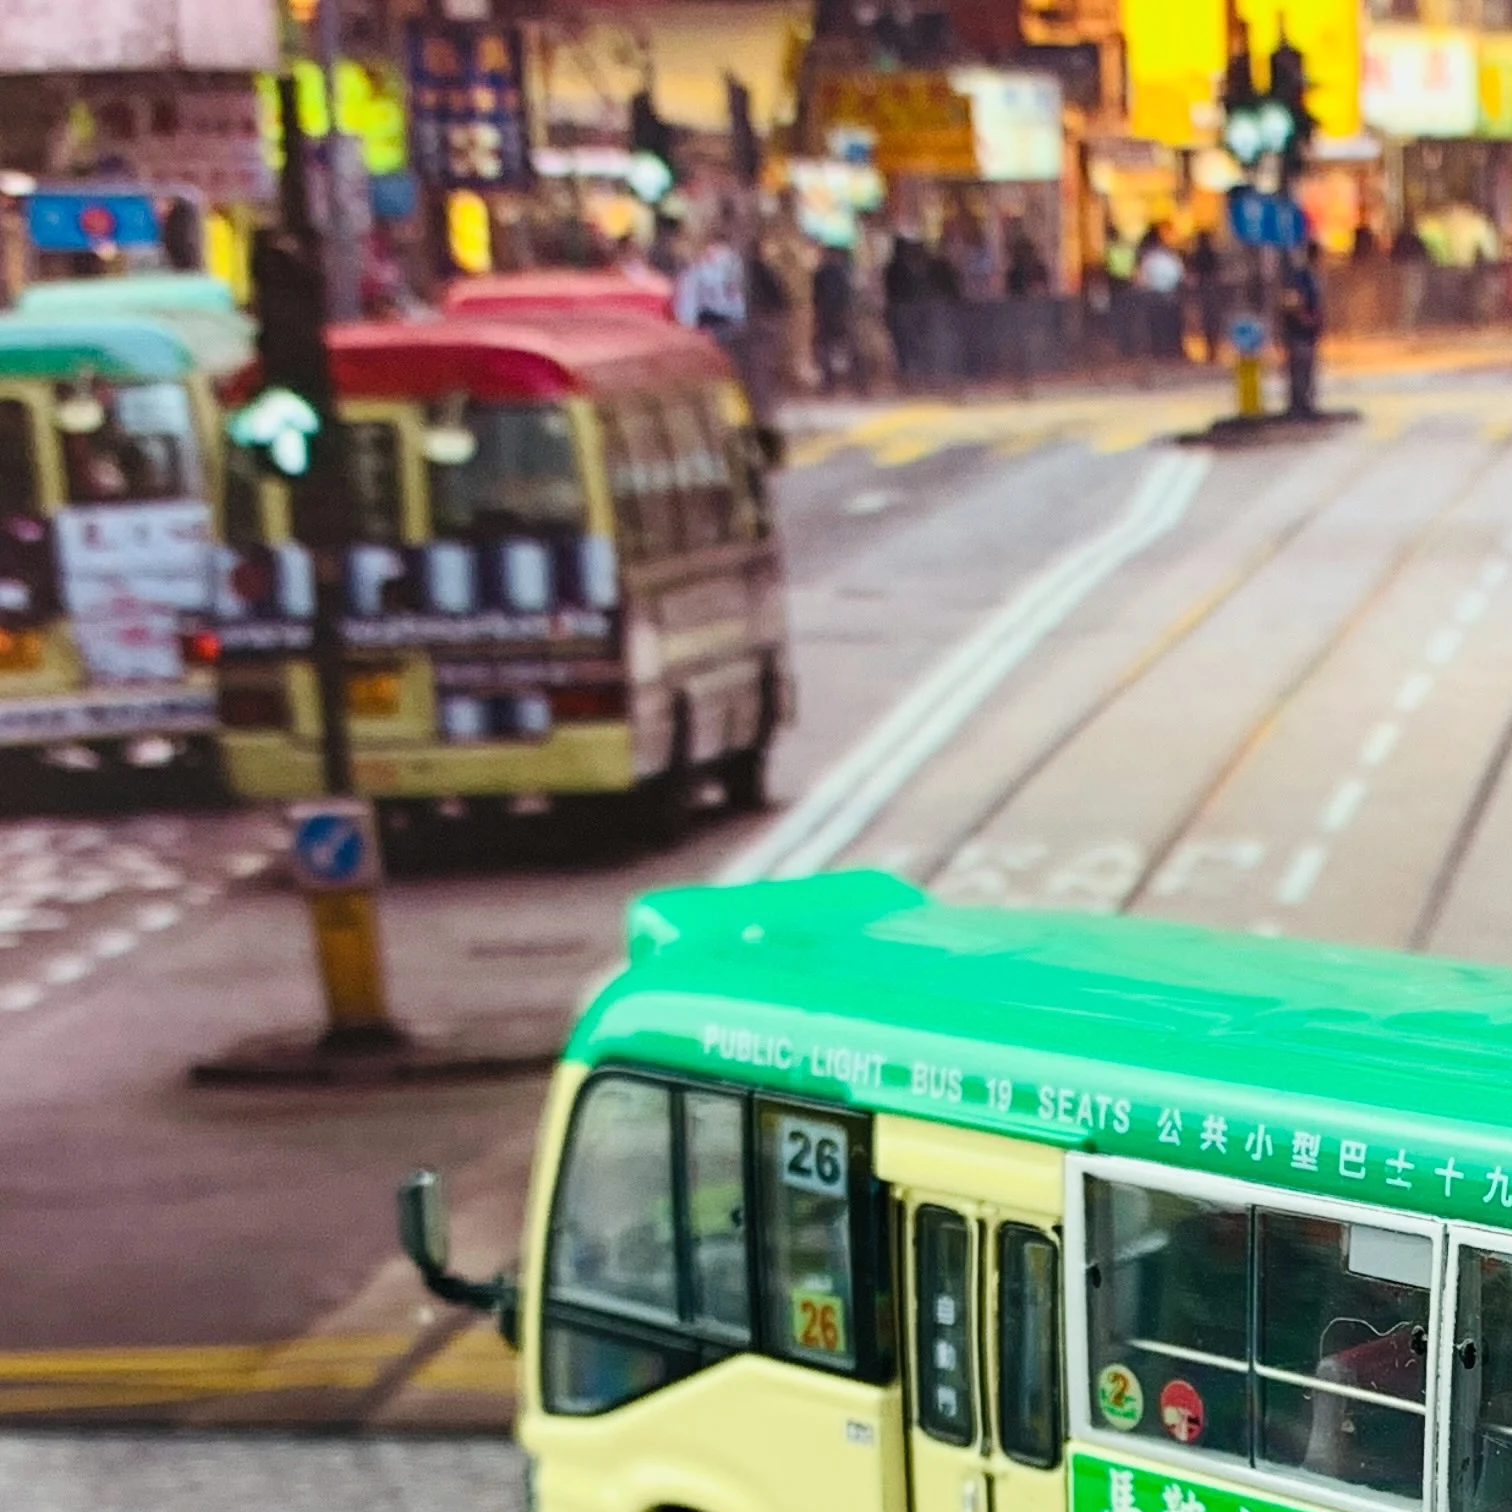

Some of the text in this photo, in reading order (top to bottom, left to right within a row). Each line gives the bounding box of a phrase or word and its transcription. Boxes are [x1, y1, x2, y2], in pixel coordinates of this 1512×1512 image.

[702, 1024, 1132, 1135] PUBLIC LIGHT BUS 19 SEATS
[786, 1130, 841, 1186] 26
[802, 1299, 839, 1351] 26
